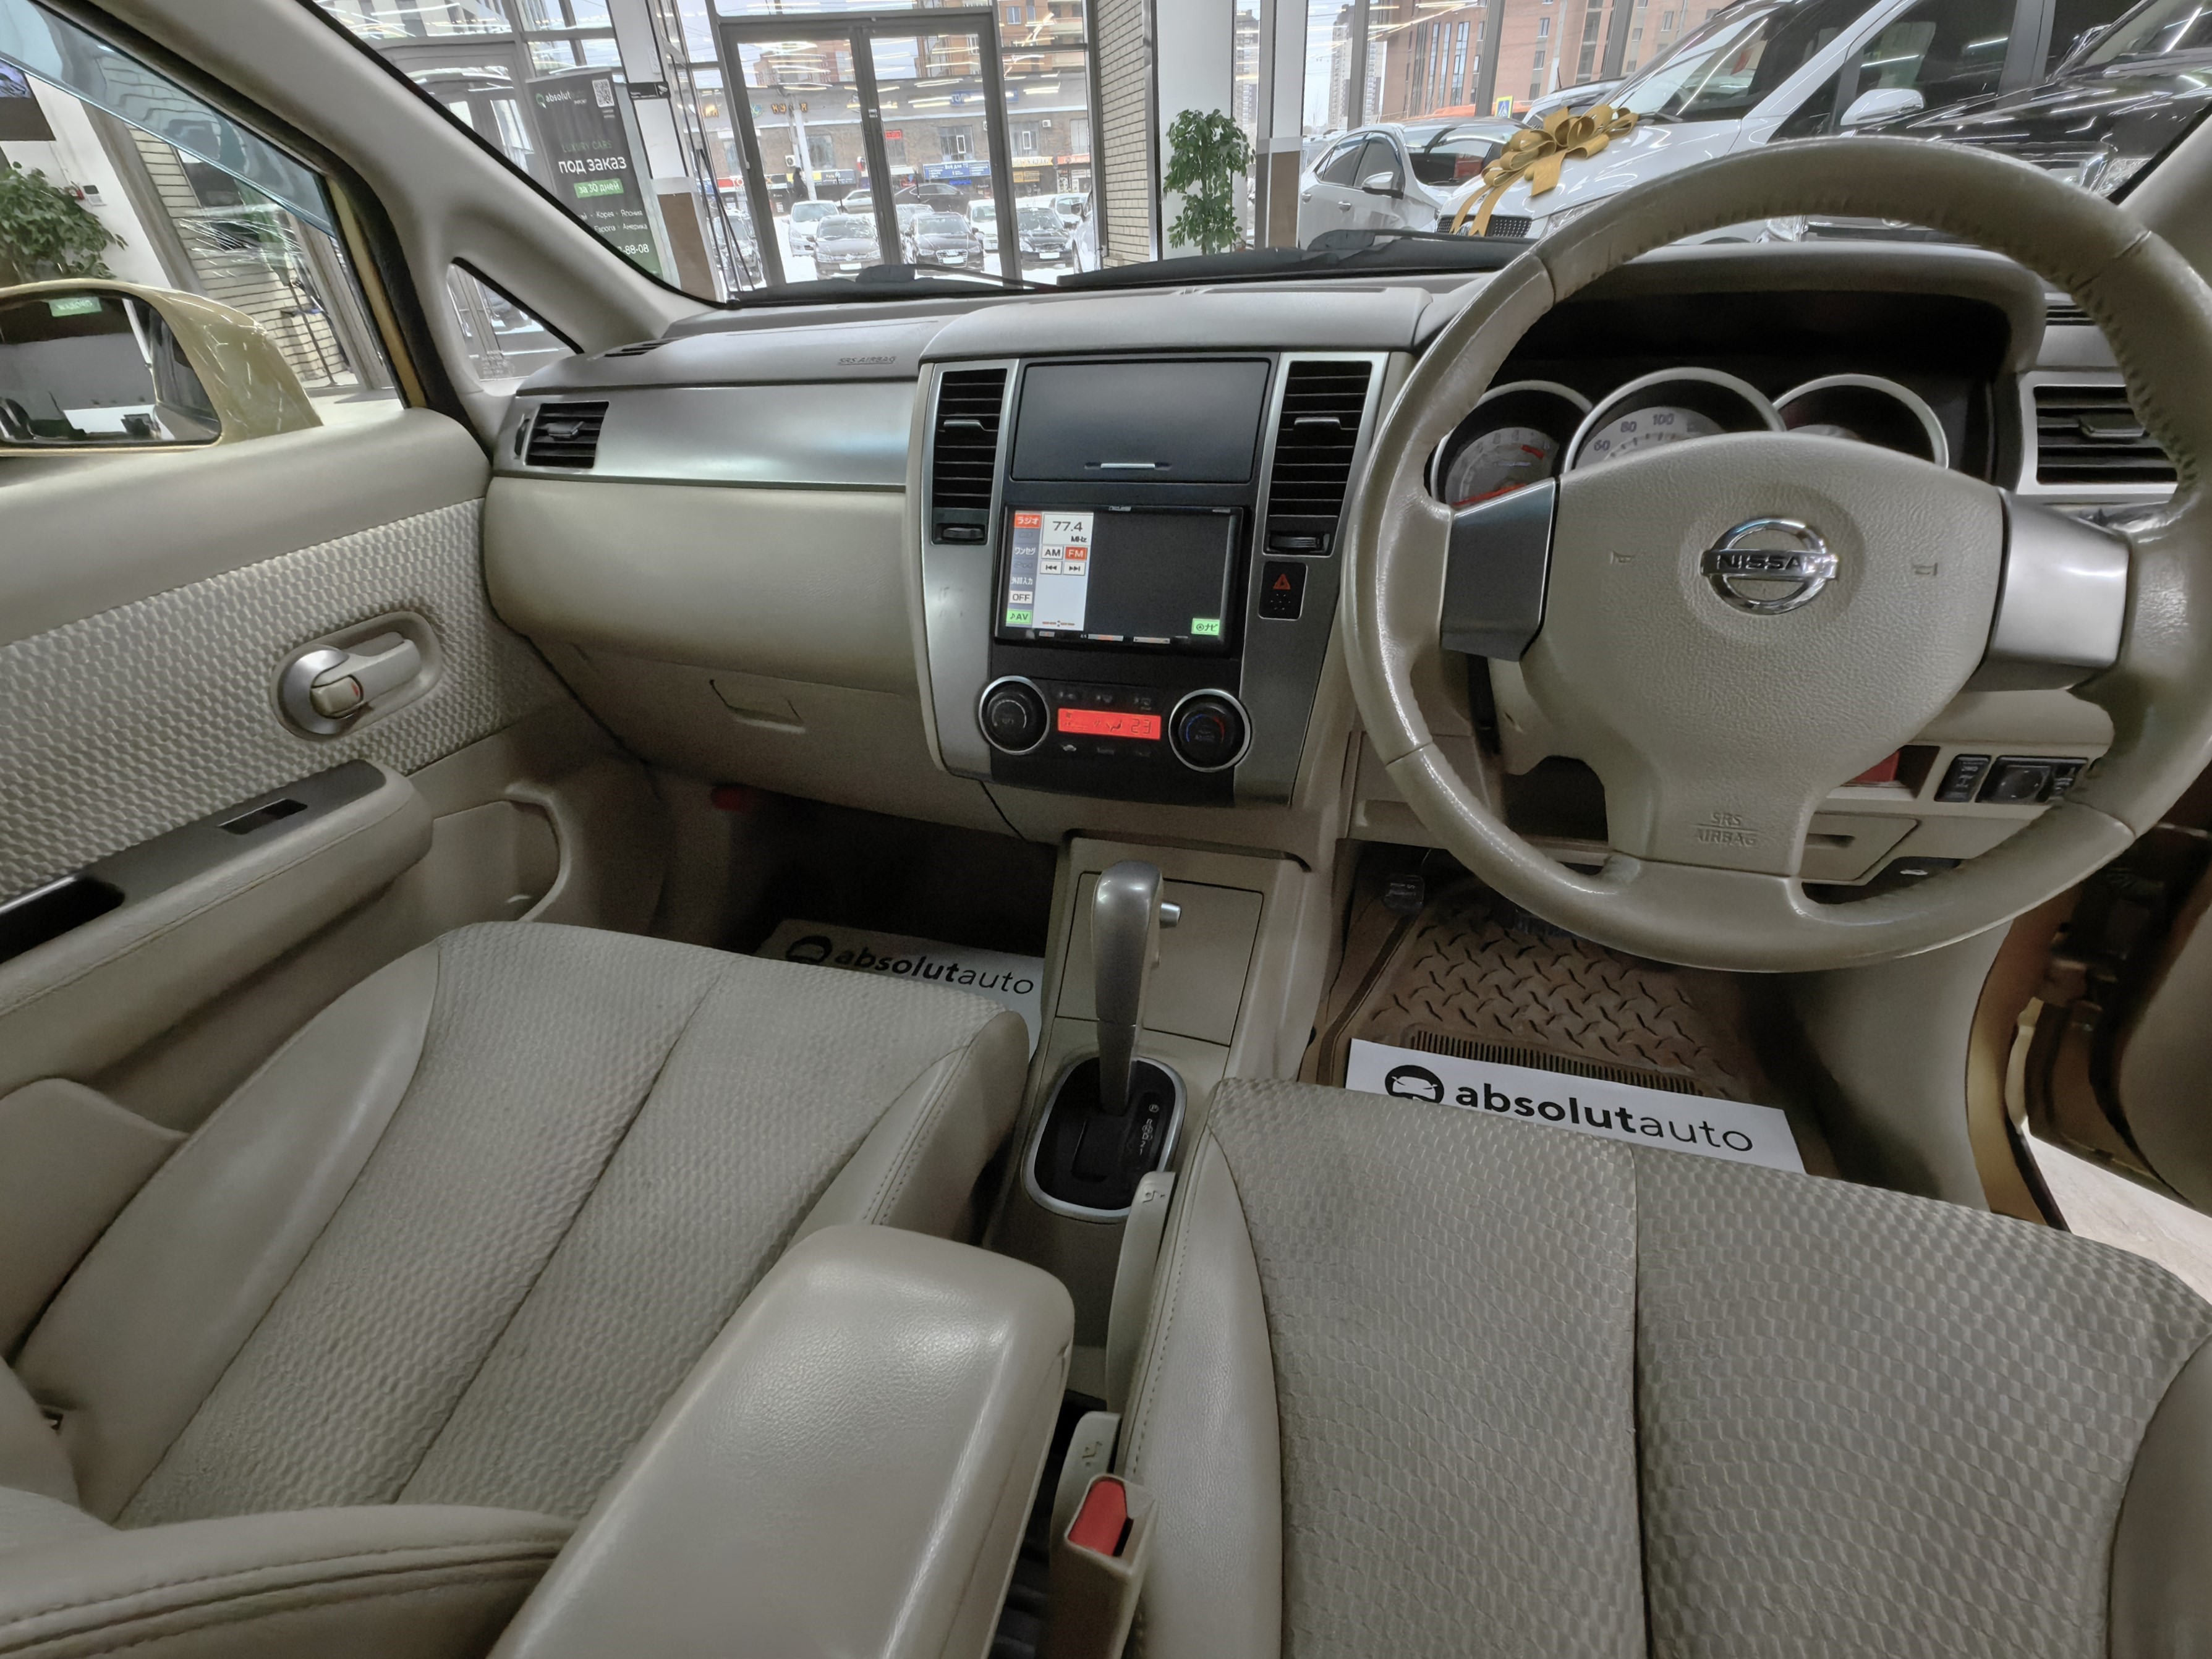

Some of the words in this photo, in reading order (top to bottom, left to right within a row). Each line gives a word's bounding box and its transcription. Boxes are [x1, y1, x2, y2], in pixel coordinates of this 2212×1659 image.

[592, 140, 613, 150] CARS
[558, 159, 587, 175] под
[587, 156, 627, 171] заказ
[588, 183, 598, 193] 30
[600, 180, 620, 193] дней
[1653, 414, 1675, 425] 100
[1620, 421, 1637, 433] 80
[1593, 439, 1610, 451] 60
[1018, 517, 1039, 525] ラジオ
[1053, 521, 1083, 532] 77.4
[1015, 547, 1036, 555] ワンセグ
[1044, 549, 1061, 557] AM
[1012, 593, 1031, 601] OFF
[1204, 623, 1219, 632] ナビ
[1131, 718, 1151, 734] 23
[1711, 812, 1742, 826] SRS
[835, 947, 1034, 995] absolutauto
[1455, 1083, 1753, 1153] absolutauto
